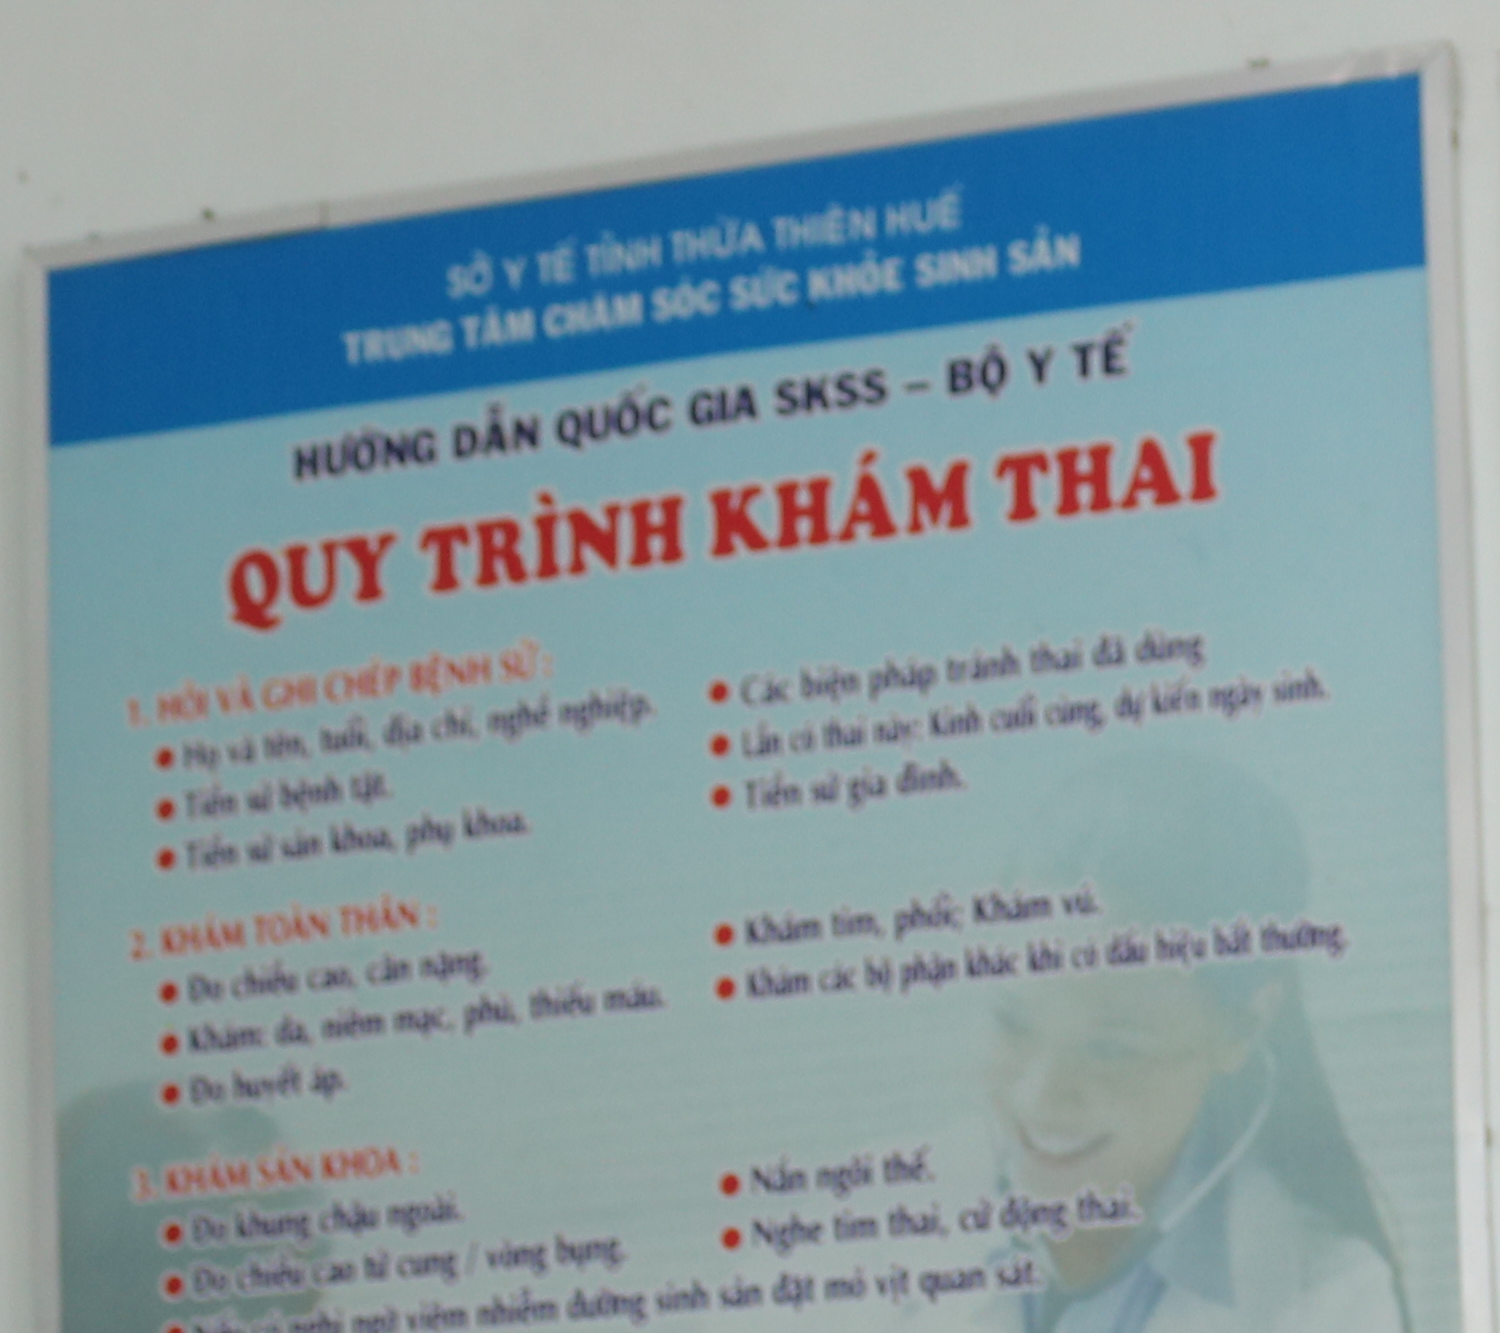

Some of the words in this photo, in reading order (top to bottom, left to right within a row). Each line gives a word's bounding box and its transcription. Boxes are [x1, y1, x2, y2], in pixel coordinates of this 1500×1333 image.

[294, 425, 435, 480] HƯỚNG
[453, 407, 538, 458] DẪN
[555, 389, 670, 448] QUỐC
[688, 386, 757, 426] GIA
[775, 369, 887, 415] SKSS
[947, 347, 1007, 395] BỘ
[1027, 349, 1051, 384] Y
[1072, 322, 1134, 378] TẾ
[228, 532, 397, 630] QUY
[419, 490, 684, 593] TRÌNH
[709, 448, 971, 557] KHÁM
[995, 430, 1218, 522] THAI
